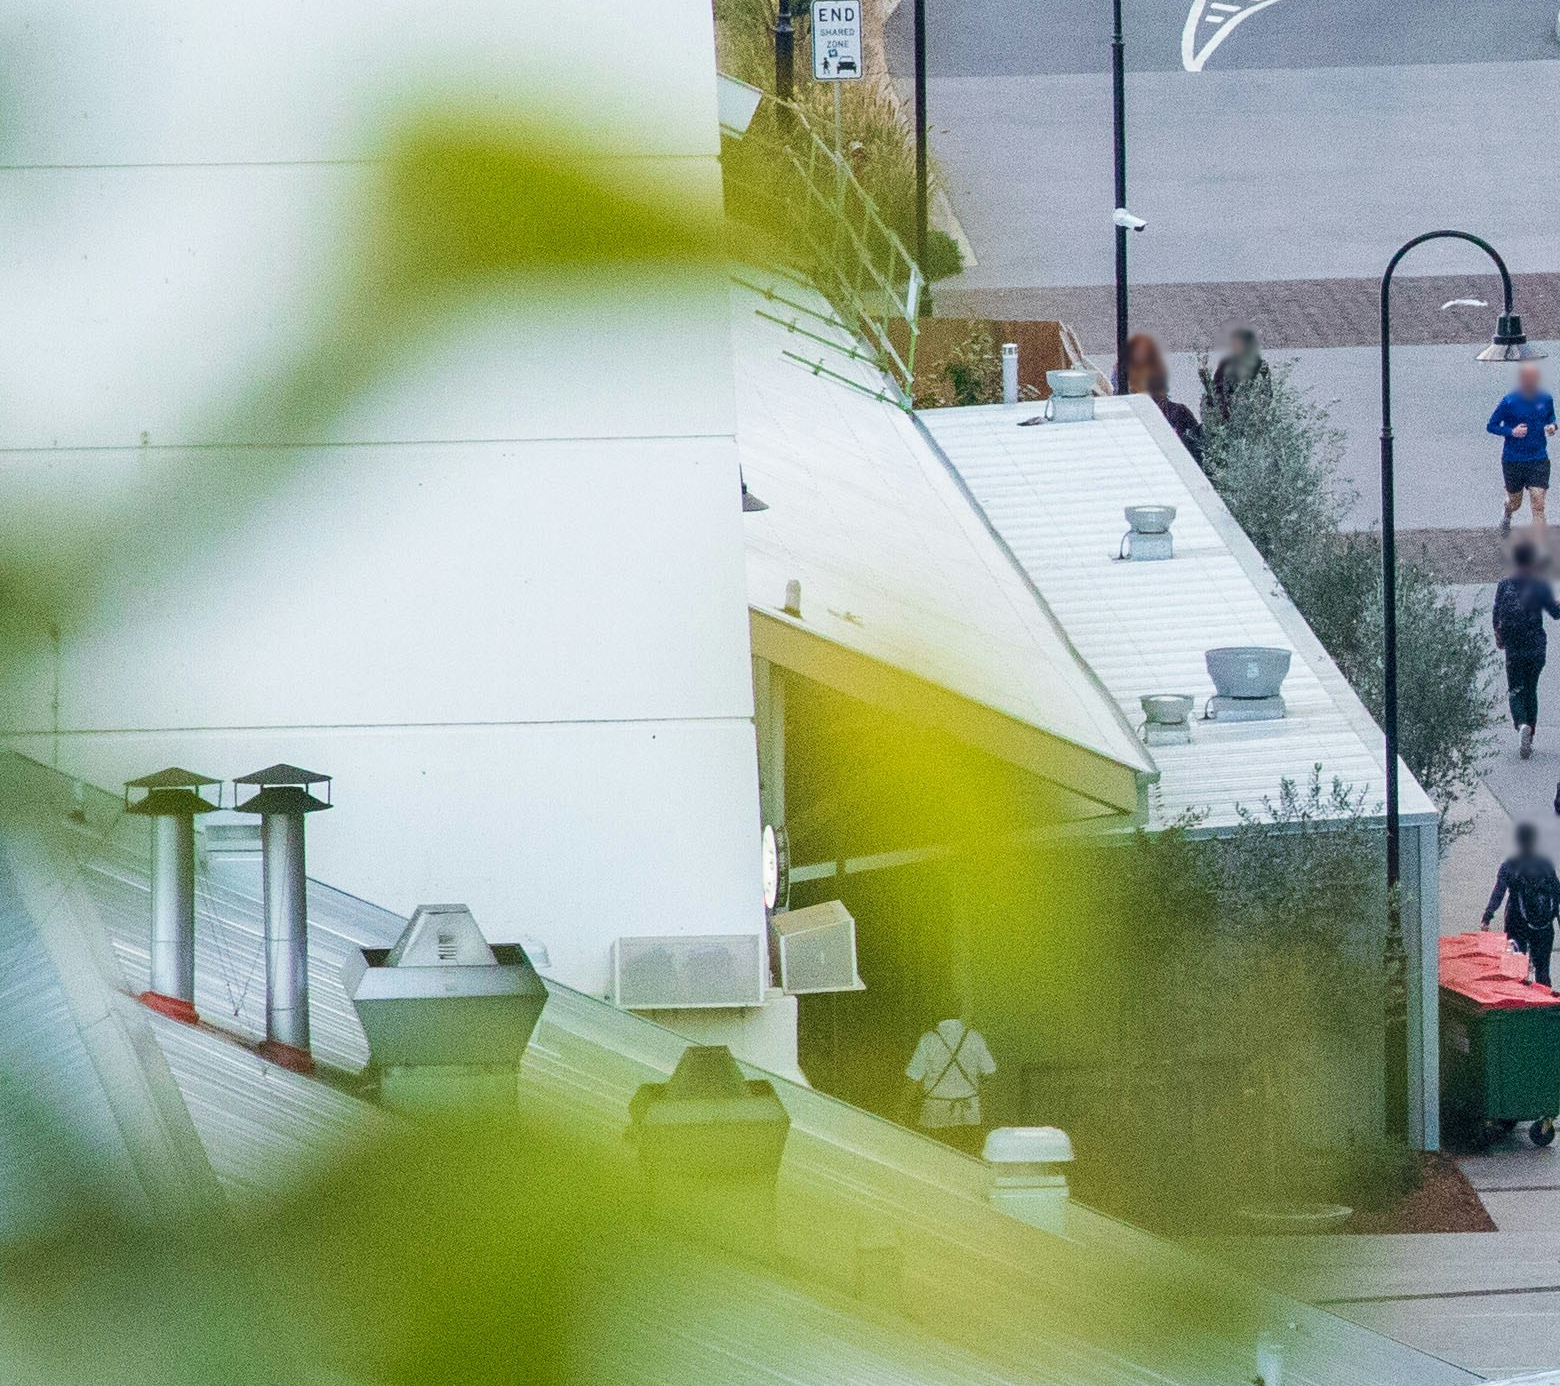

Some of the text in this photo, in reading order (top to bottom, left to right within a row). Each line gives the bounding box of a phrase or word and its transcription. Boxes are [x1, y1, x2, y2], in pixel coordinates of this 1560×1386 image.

[819, 8, 855, 22] END
[820, 28, 855, 36] SHARED
[827, 40, 849, 48] ZONE
